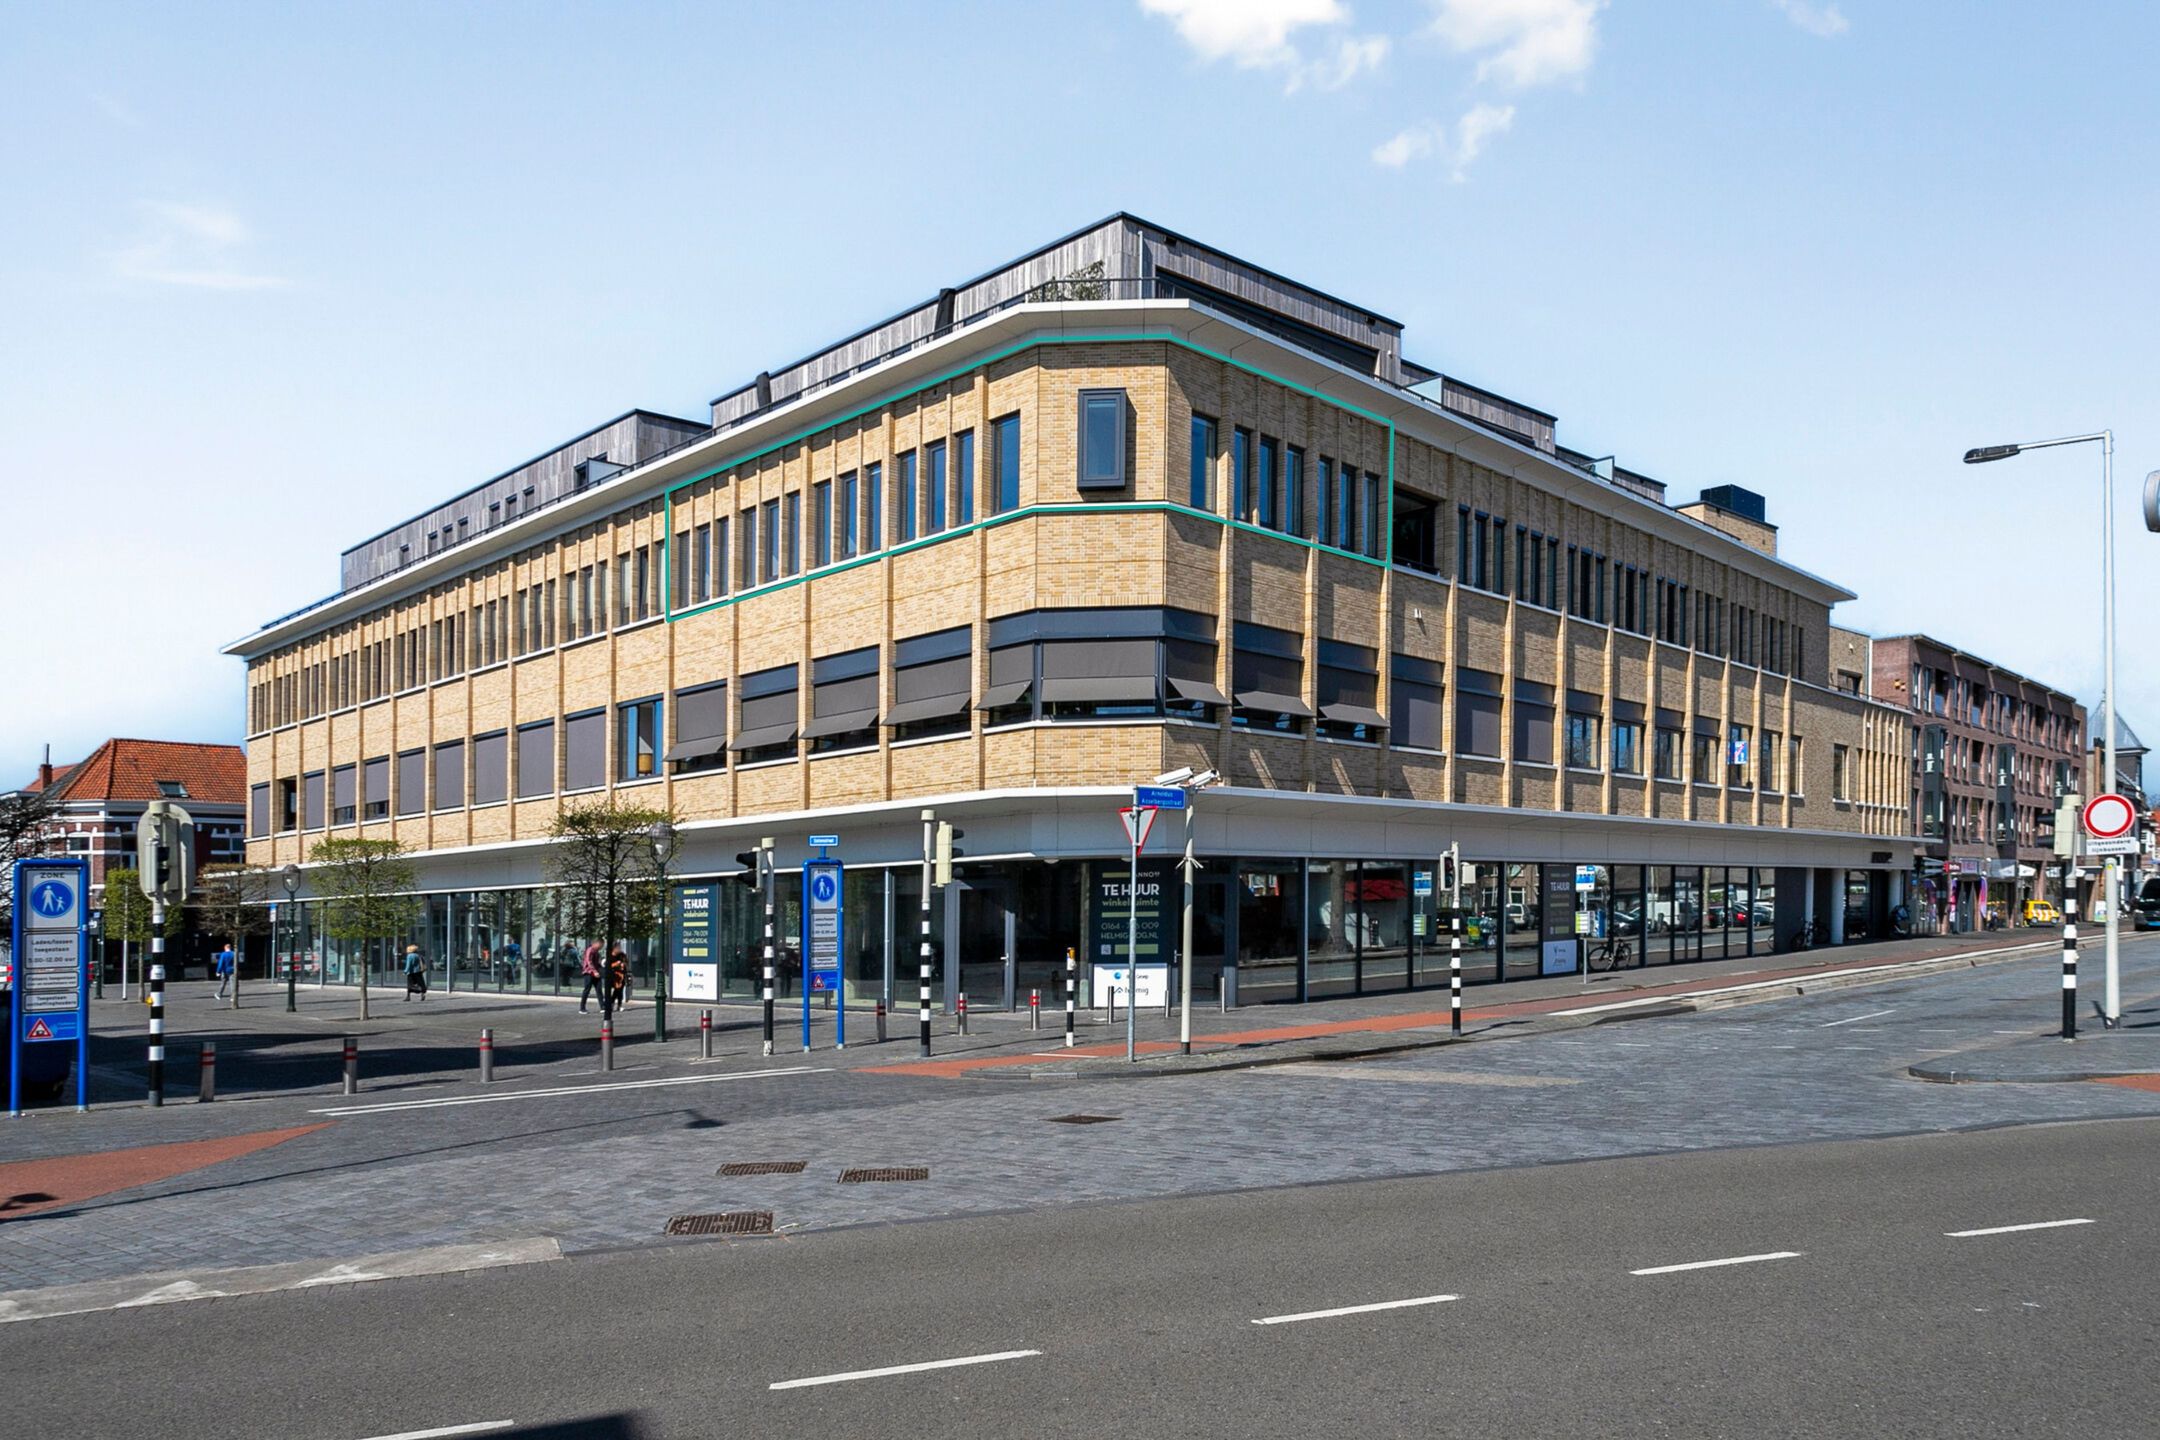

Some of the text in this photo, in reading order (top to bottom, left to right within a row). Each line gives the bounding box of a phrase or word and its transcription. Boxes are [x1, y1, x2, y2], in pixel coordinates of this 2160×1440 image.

[1102, 884, 1160, 896] TE HUUR
[692, 898, 709, 910] HUUR
[1102, 898, 1159, 907] winkeluimte
[1101, 931, 1159, 940] HELMIG-OG.NL
